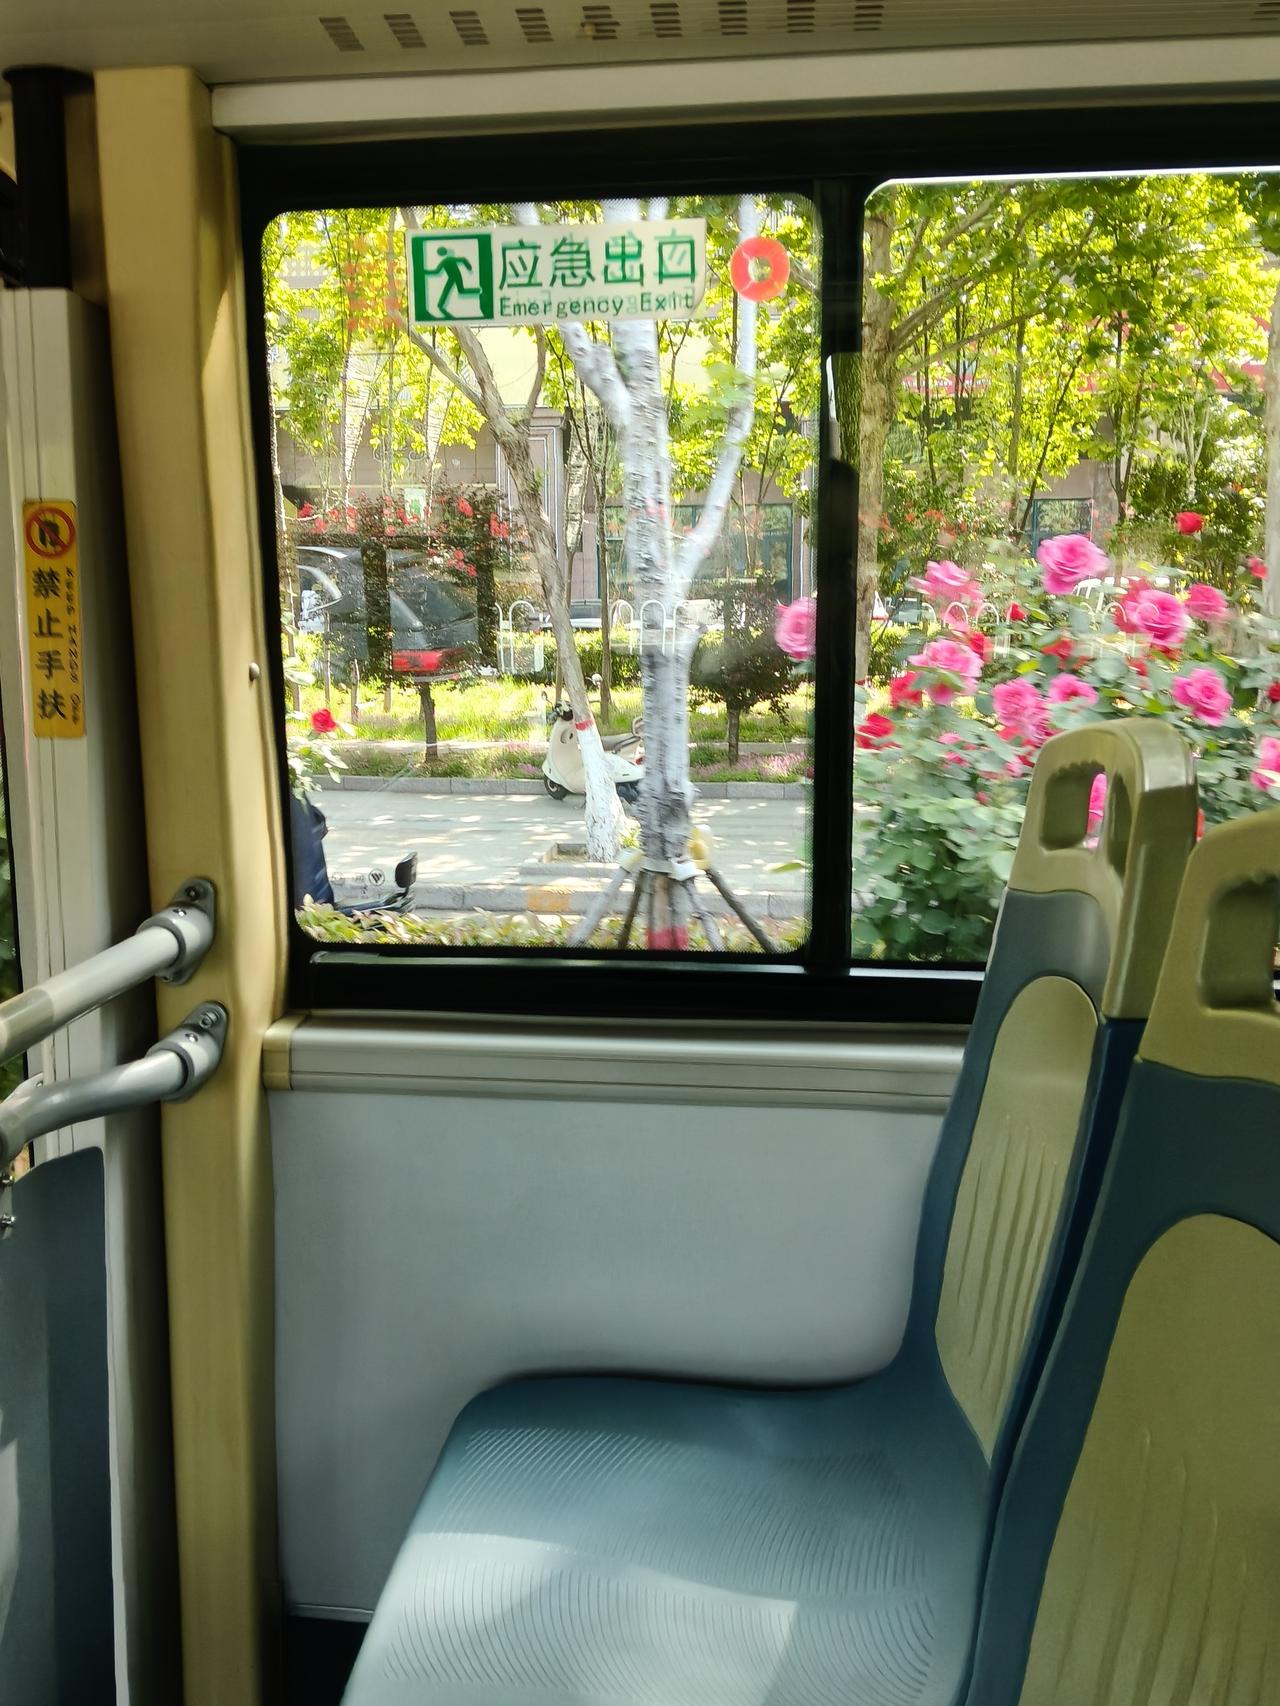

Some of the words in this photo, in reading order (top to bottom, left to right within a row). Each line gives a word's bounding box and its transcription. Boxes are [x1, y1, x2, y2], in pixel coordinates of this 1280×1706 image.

[498, 235, 696, 290] 应急出口
[499, 297, 624, 319] Emergency
[639, 291, 696, 312] Exit
